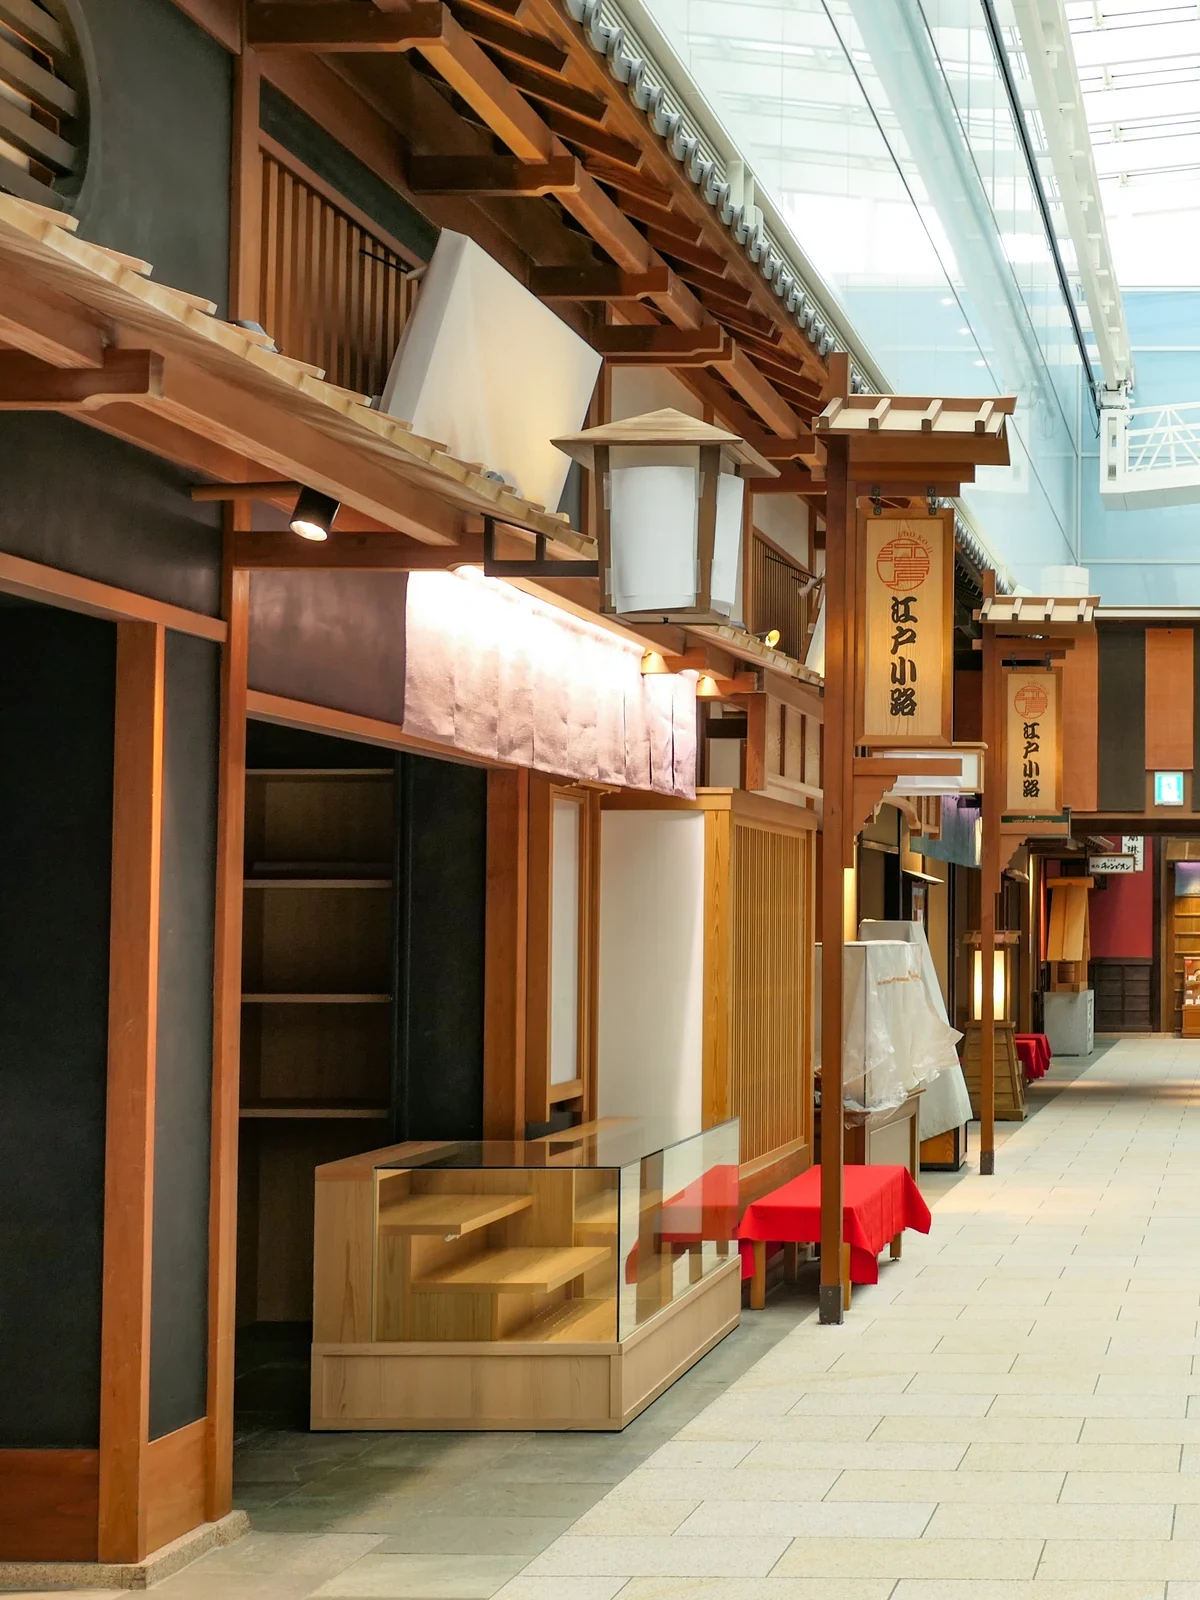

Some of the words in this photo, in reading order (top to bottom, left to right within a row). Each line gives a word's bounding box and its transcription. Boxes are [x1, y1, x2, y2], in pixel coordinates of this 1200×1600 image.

[890, 596, 918, 717] 江戸小路
[1022, 721, 1041, 798] 江戸小路
